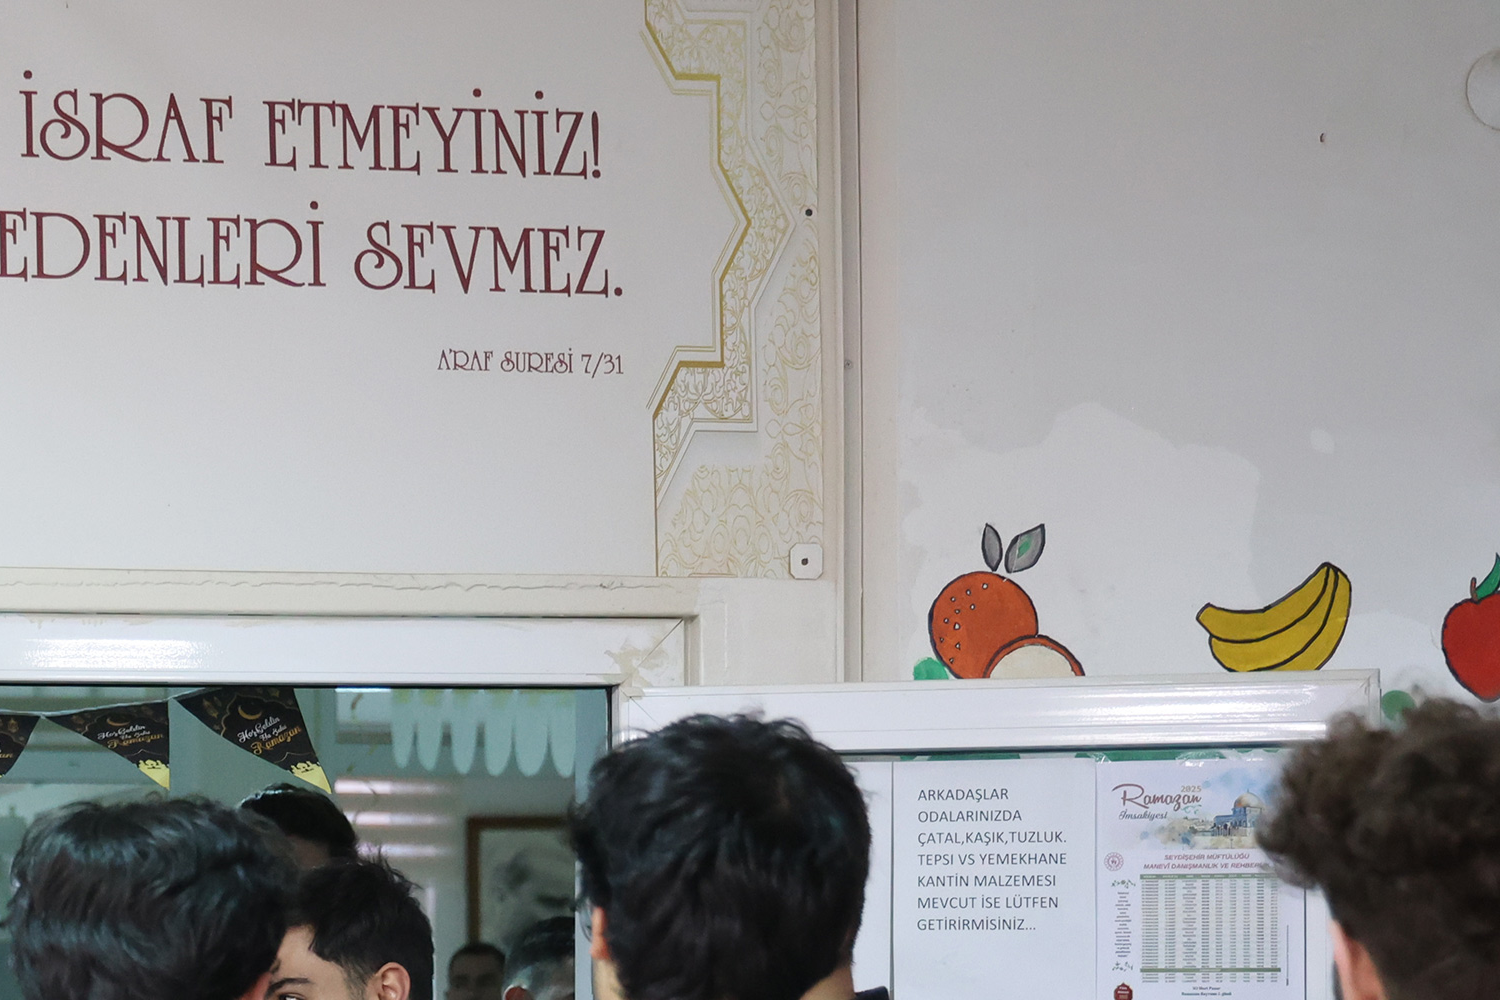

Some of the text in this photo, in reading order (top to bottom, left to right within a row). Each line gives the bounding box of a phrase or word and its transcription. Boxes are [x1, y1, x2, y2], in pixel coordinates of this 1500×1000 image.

[19, 70, 233, 164] İSRAF
[263, 88, 602, 180] ETMEYİNİZ!
[354, 220, 623, 298] SEVMEZ.
[500, 348, 574, 374] SURESİ
[581, 352, 624, 379] 7/31
[250, 725, 303, 756] Ramazan
[917, 788, 1009, 803] ARKADAŞLAR
[1180, 785, 1202, 793] 2025
[1111, 783, 1203, 812] Ramazan
[917, 809, 1023, 823] ODALARINIZDA
[1118, 808, 1168, 822] İmsakiyesi
[917, 830, 1068, 847] ÇATAL,KAŞIK,TUZLUK.
[917, 853, 1067, 866] TEPSI VS YEMEKHANE
[1164, 852, 1250, 862] SEYDİŞEHİR MÜFTÜLÜĞÜ
[917, 872, 1056, 888] KANTİN MALZEMESI
[917, 894, 1059, 909] MEVCUT İSE LÜTFEN
[916, 916, 1036, 931] GETİRİRMİSİNİZ...
